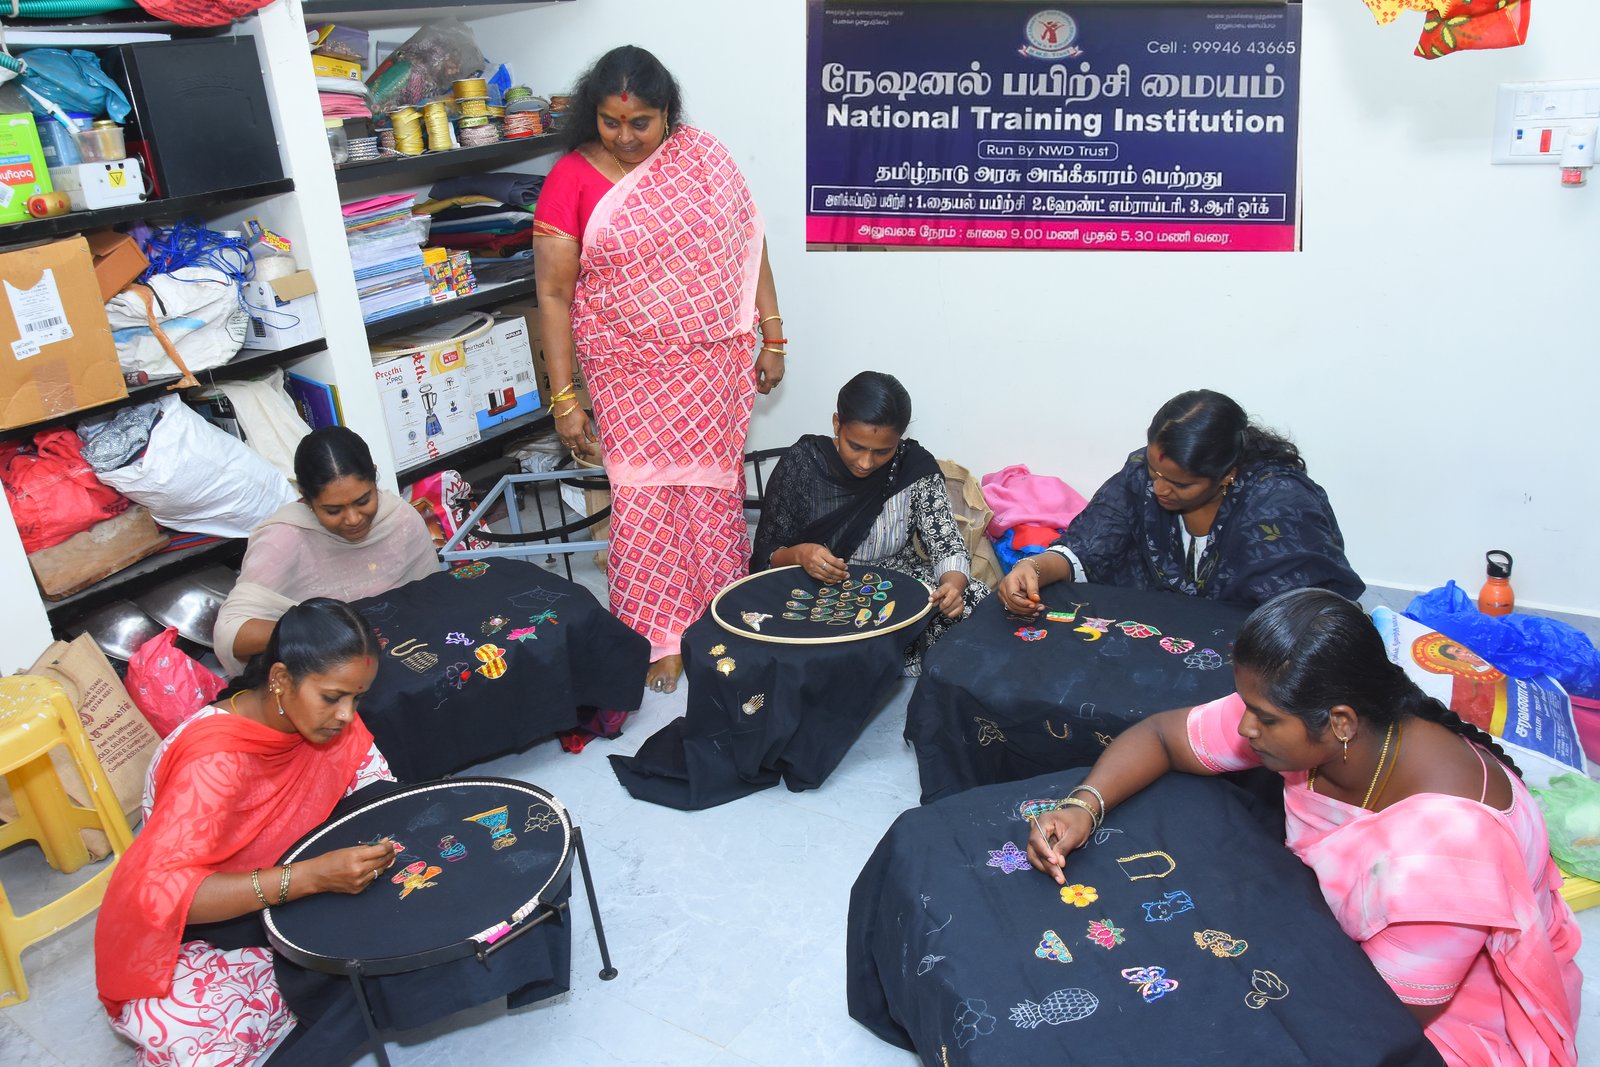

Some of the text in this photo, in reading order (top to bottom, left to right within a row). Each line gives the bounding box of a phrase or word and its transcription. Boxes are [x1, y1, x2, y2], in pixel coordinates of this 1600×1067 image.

[1147, 40, 1177, 54] Cell
[1192, 41, 1241, 54] 99946
[1247, 41, 1296, 54] 43665
[821, 61, 1285, 106] நேஷனல் பயிற்சி மையம்
[826, 103, 1285, 137] National Training Institution
[986, 144, 1109, 157] Run By NWD Trust
[874, 161, 1223, 189] தமிழ்நாடு அரசு அங்கீகாரம் பெற்றது
[880, 193, 906, 210] பயிற்சி
[979, 195, 1026, 214] பயிற்சி
[858, 225, 917, 239] அலுவலக
[919, 225, 956, 241] நேரம்
[966, 227, 1007, 239] காலை
[1011, 228, 1043, 240] 9.00
[1046, 229, 1079, 240] மணி
[1082, 229, 1118, 244] முதல்
[1121, 230, 1154, 242] 5.30
[1156, 230, 1191, 242] மணி
[1193, 233, 1233, 245] வரை.
[374, 366, 402, 380] Preethi
[98, 747, 113, 761] OLD,
